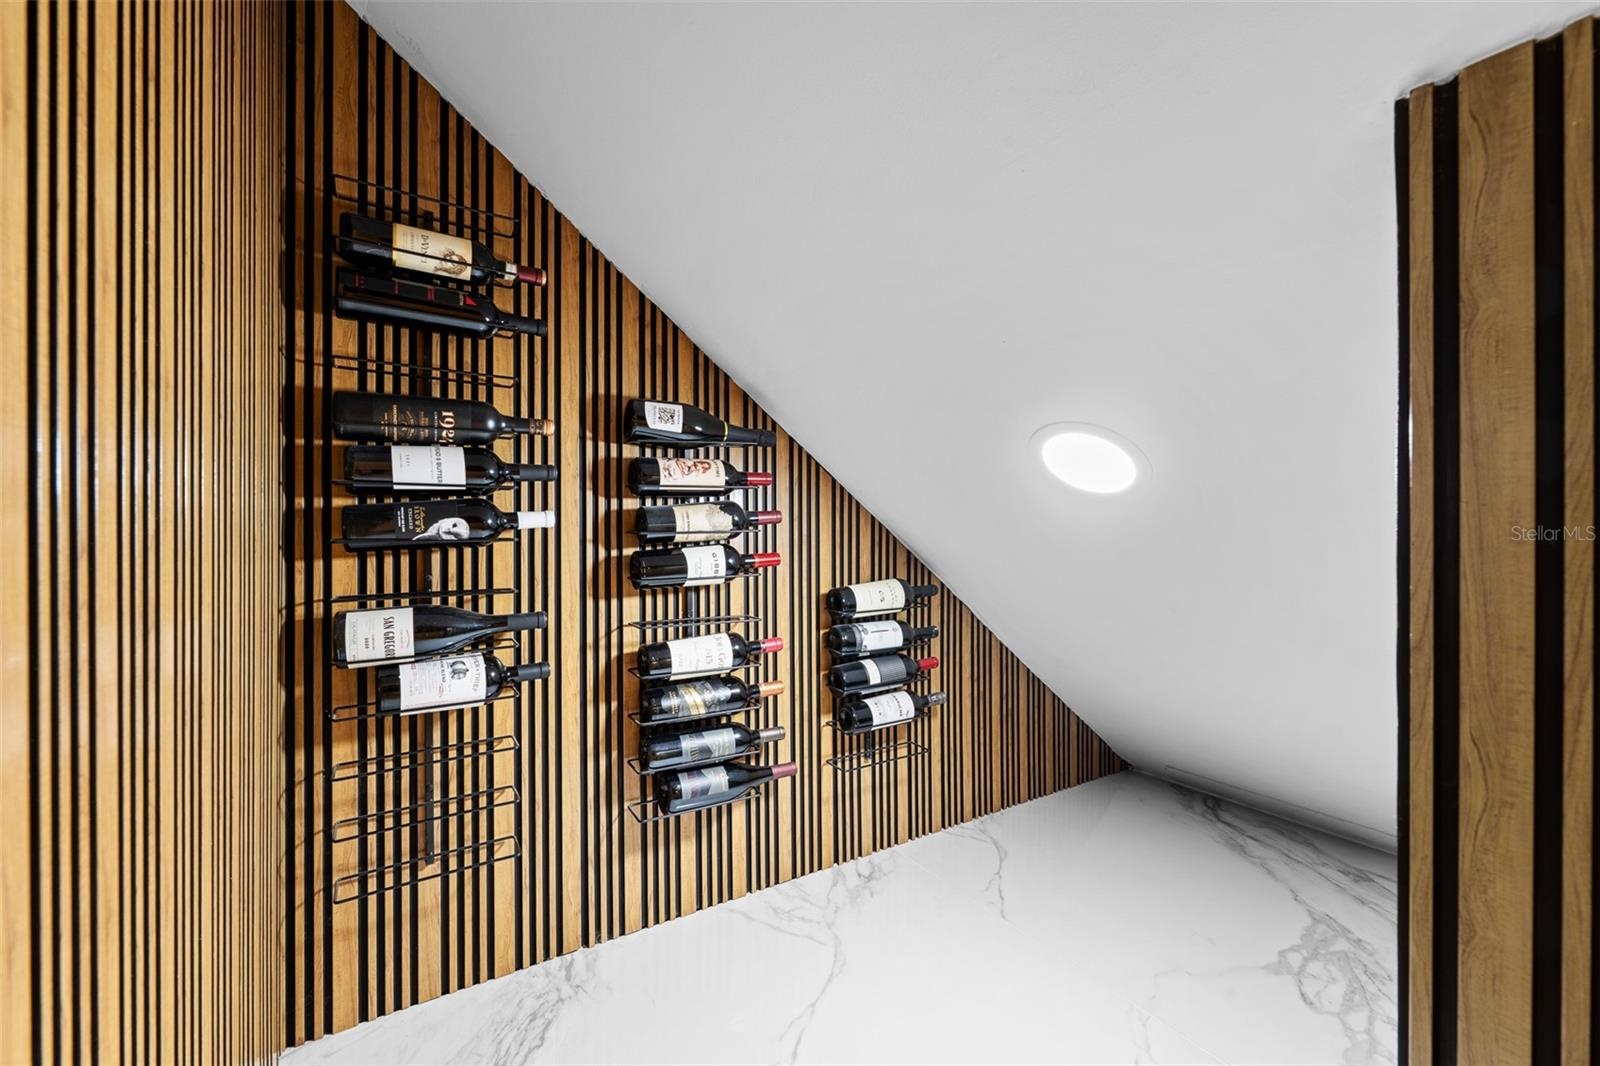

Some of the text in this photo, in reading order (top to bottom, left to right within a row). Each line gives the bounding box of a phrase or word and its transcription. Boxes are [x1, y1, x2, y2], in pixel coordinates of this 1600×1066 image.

[438, 411, 455, 443] 1924
[711, 551, 720, 578] GIBB
[383, 616, 396, 659] SAN GREGOR
